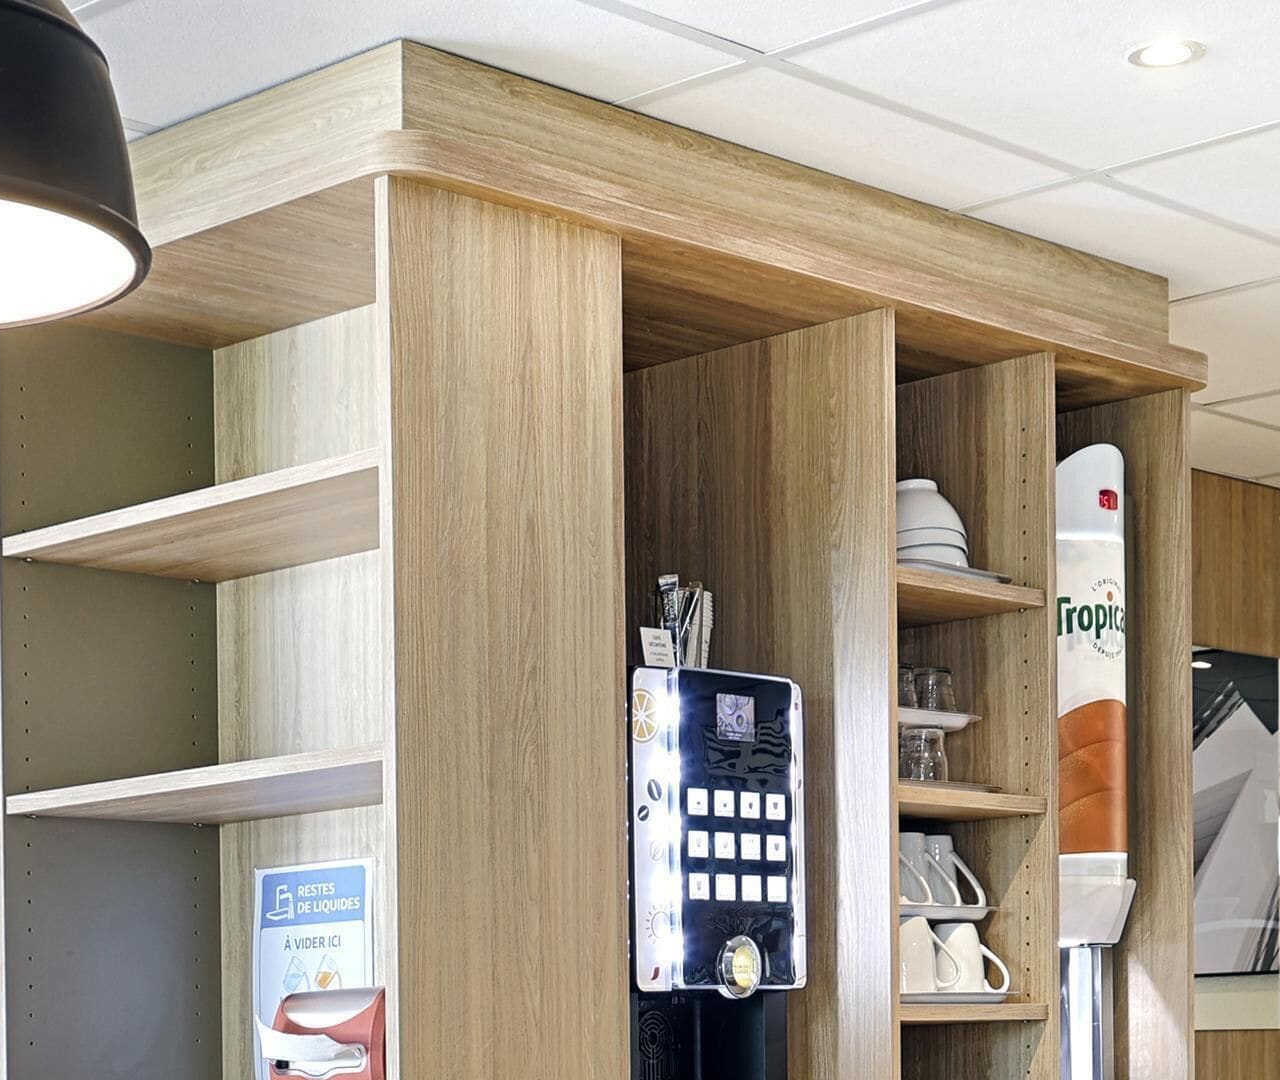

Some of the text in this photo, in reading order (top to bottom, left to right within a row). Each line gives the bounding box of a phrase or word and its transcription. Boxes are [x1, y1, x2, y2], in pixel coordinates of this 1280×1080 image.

[1056, 591, 1125, 640] Tropica
[297, 882, 336, 897] RESTES
[297, 896, 361, 914] DE LIQUIDES
[284, 934, 341, 951] À VIDER ICI
